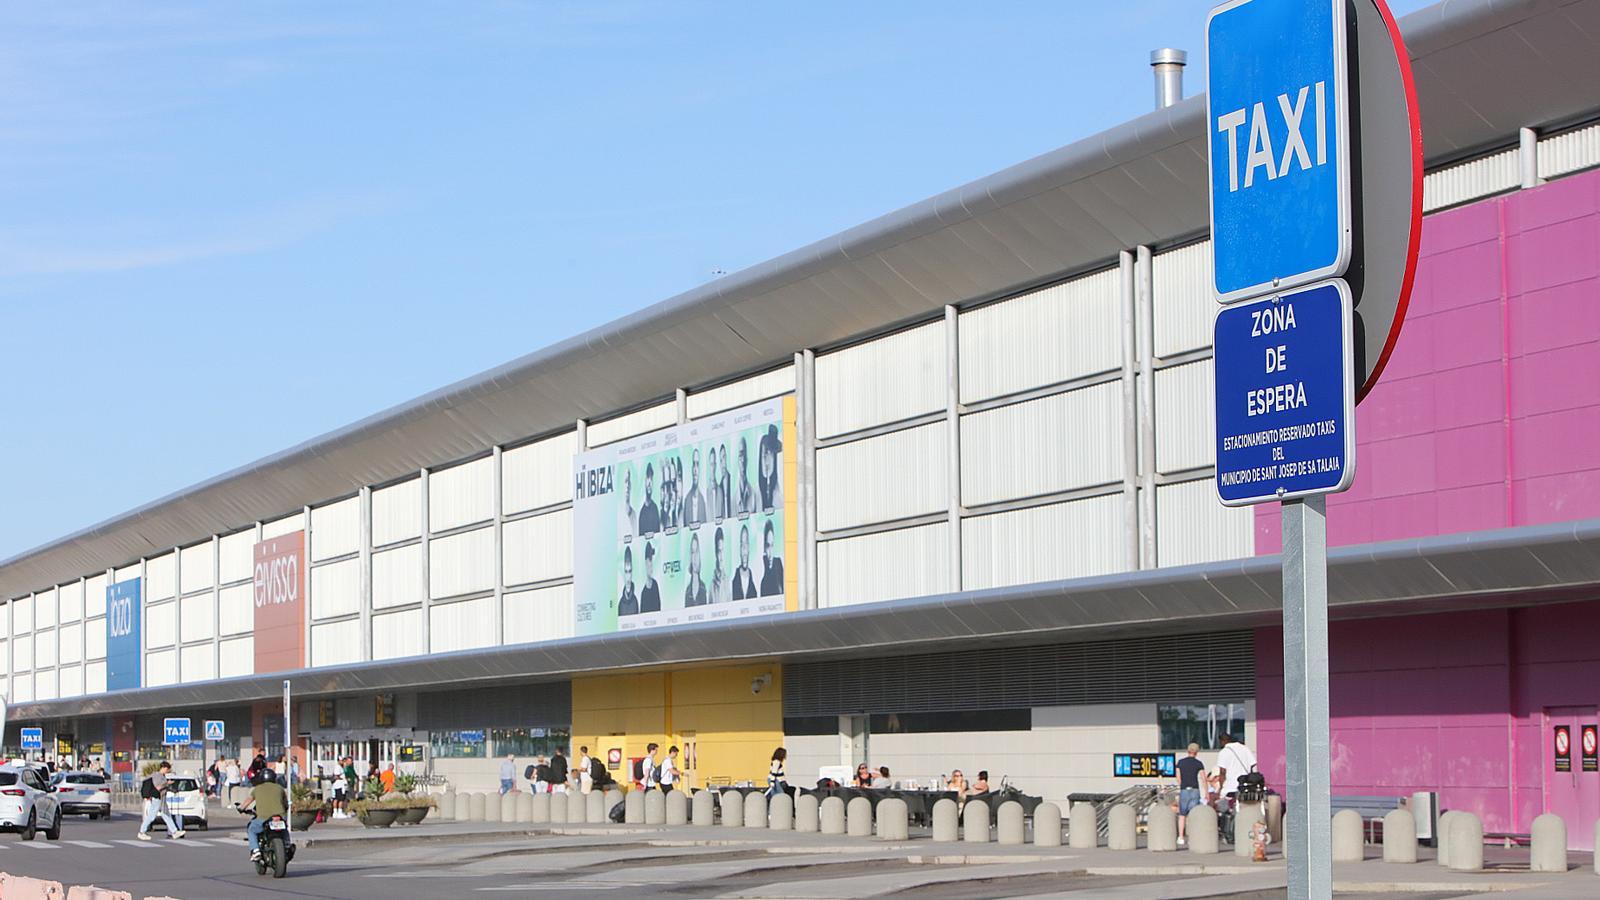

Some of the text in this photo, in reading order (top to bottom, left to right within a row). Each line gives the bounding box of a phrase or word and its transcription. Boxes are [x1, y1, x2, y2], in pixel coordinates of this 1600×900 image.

[1217, 80, 1327, 193] TAXI
[1251, 303, 1297, 338] ZONA
[1265, 345, 1287, 374] DE
[1247, 381, 1308, 417] ESPERA
[1223, 420, 1336, 451] ESTACIONAMIENTO RESERVADO TAXIS
[1272, 446, 1285, 461] DEL
[587, 464, 614, 498] IBIZA
[1221, 456, 1340, 487] MUNICIPIO DE SANT JOSEP DE SA TALAIA
[254, 543, 297, 608] eivissa
[166, 727, 189, 736] TAXI
[1140, 757, 1151, 776] 30
